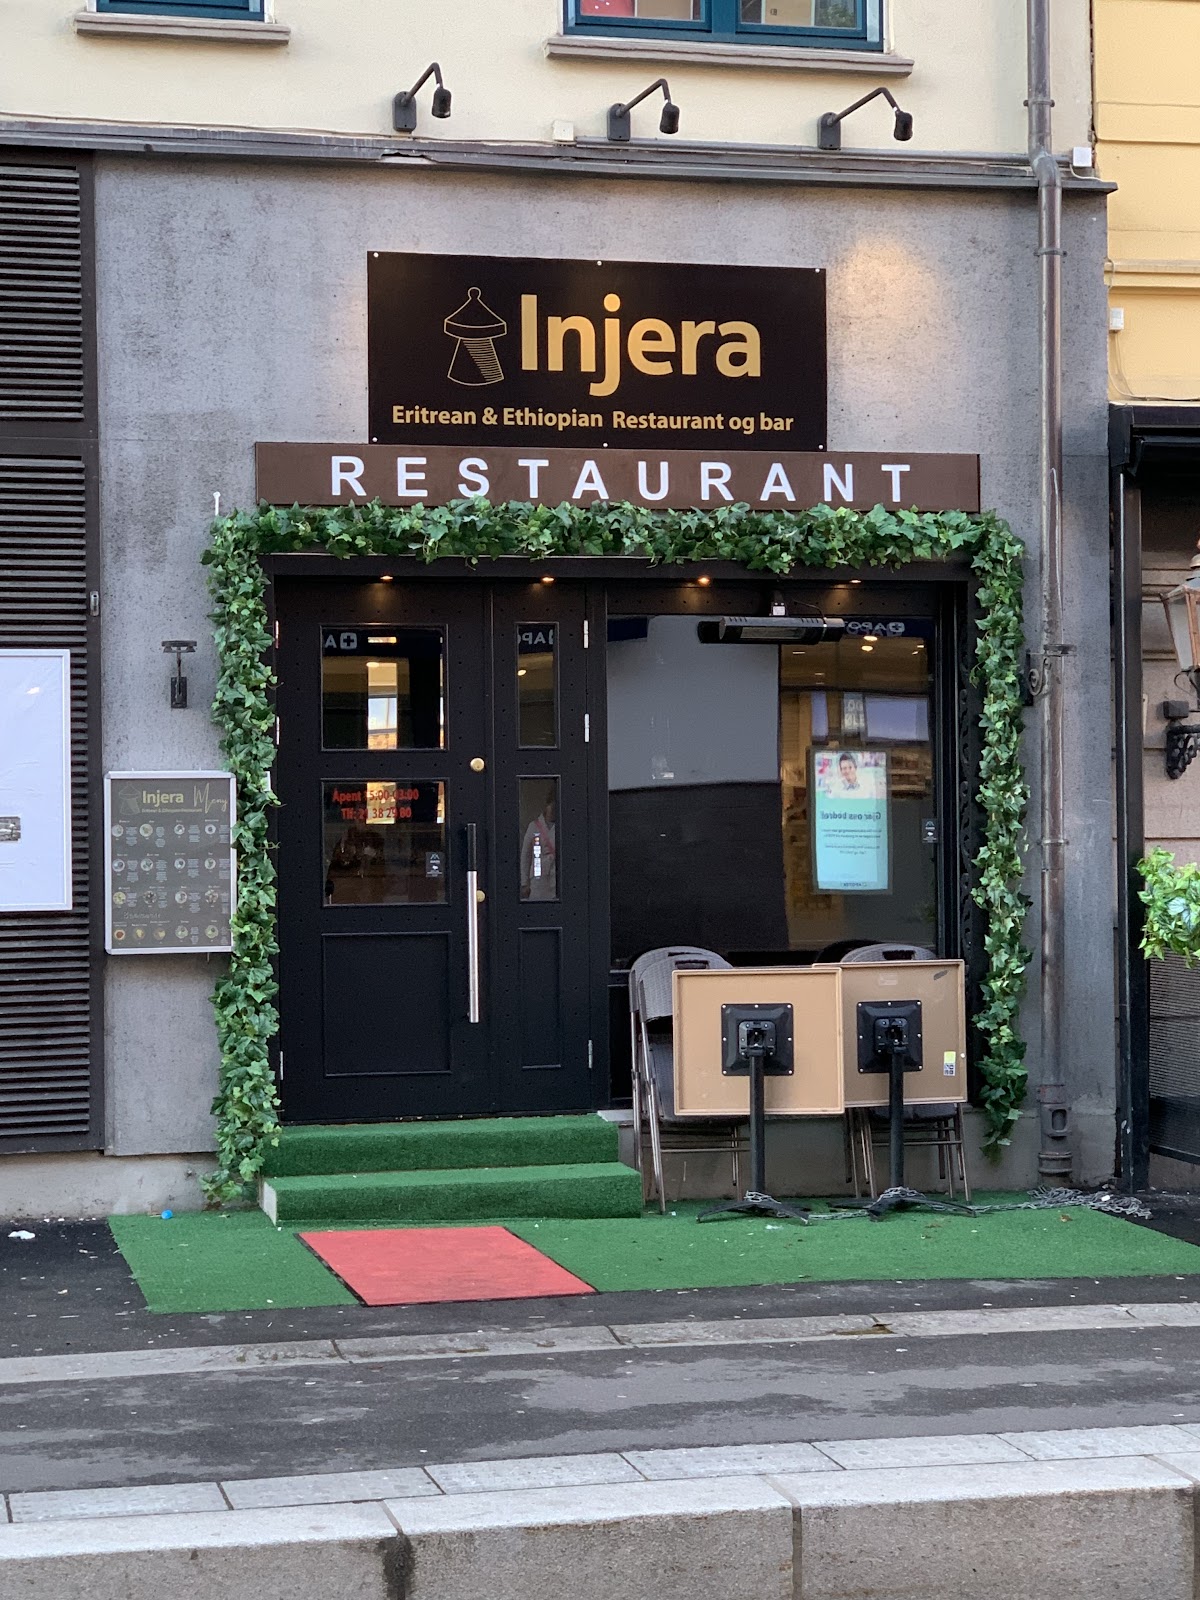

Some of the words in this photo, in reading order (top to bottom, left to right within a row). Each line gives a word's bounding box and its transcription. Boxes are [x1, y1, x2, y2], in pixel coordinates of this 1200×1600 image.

[521, 293, 761, 397] Injera
[392, 405, 477, 425] Eritrean
[481, 406, 498, 425] &
[503, 407, 603, 431] Ethiopian
[612, 410, 725, 430] Restaurant
[728, 416, 755, 435] og
[759, 412, 794, 431] bar
[331, 455, 911, 503] RESTAURANT
[142, 789, 184, 807] Injera
[372, 807, 384, 819] 38
